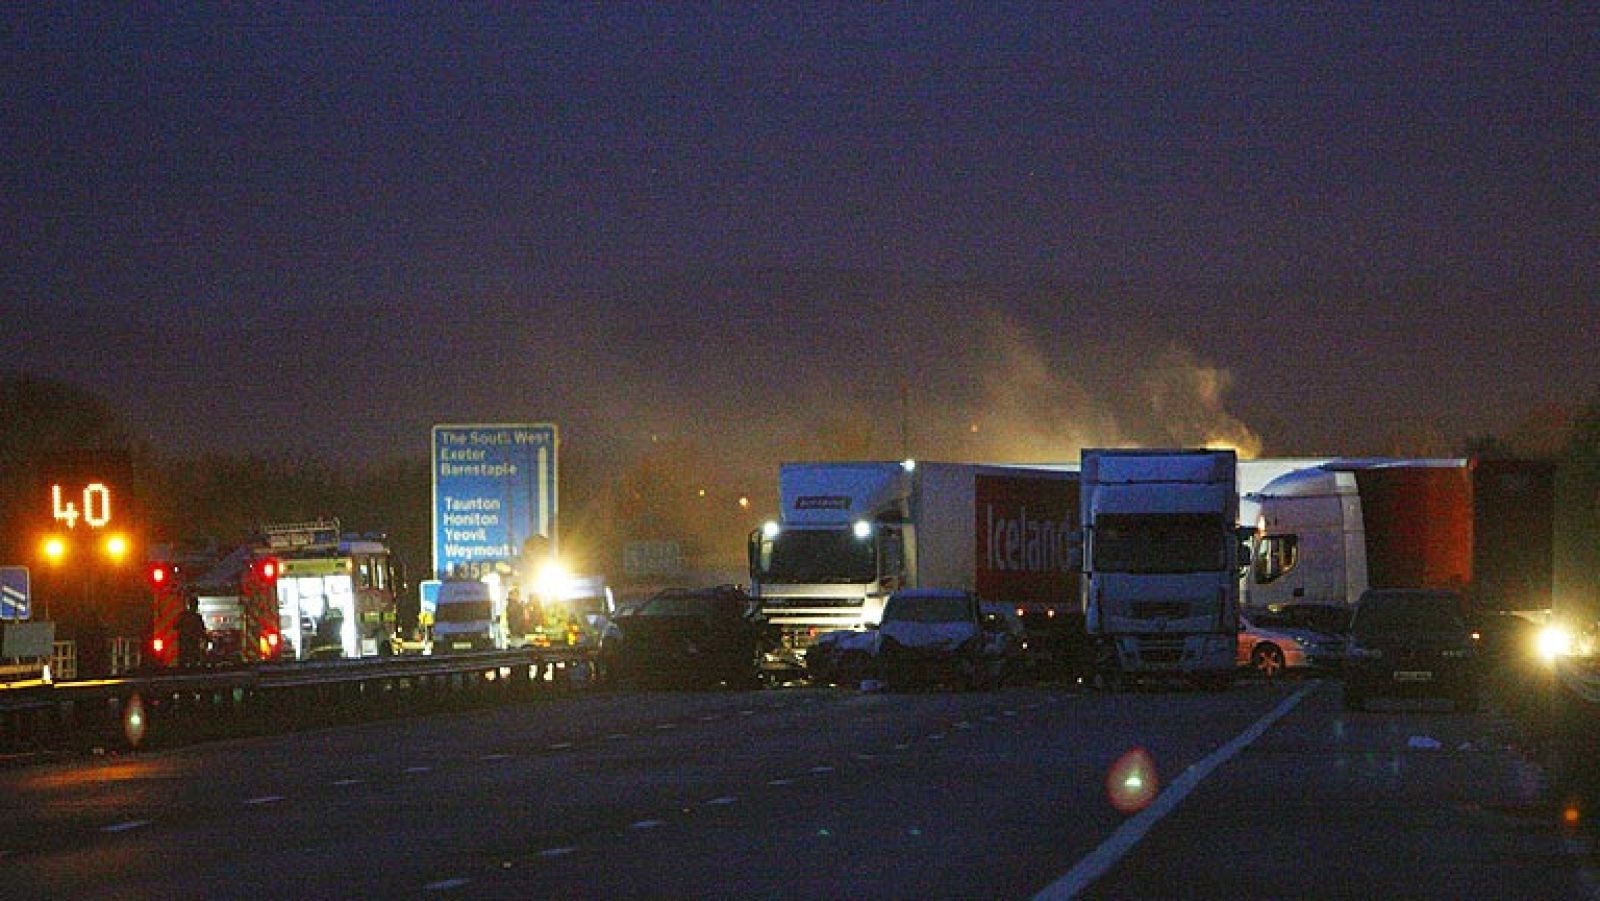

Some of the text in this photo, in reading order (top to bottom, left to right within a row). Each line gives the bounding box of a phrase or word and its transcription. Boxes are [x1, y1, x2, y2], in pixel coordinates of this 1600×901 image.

[441, 431, 467, 445] The
[514, 430, 551, 445] West
[441, 447, 486, 461] Exeter
[441, 462, 518, 477] Barnstaple
[52, 483, 111, 529] 40
[444, 496, 501, 511] Taunton
[443, 512, 499, 527] Honiton
[444, 527, 487, 542] Yeovil
